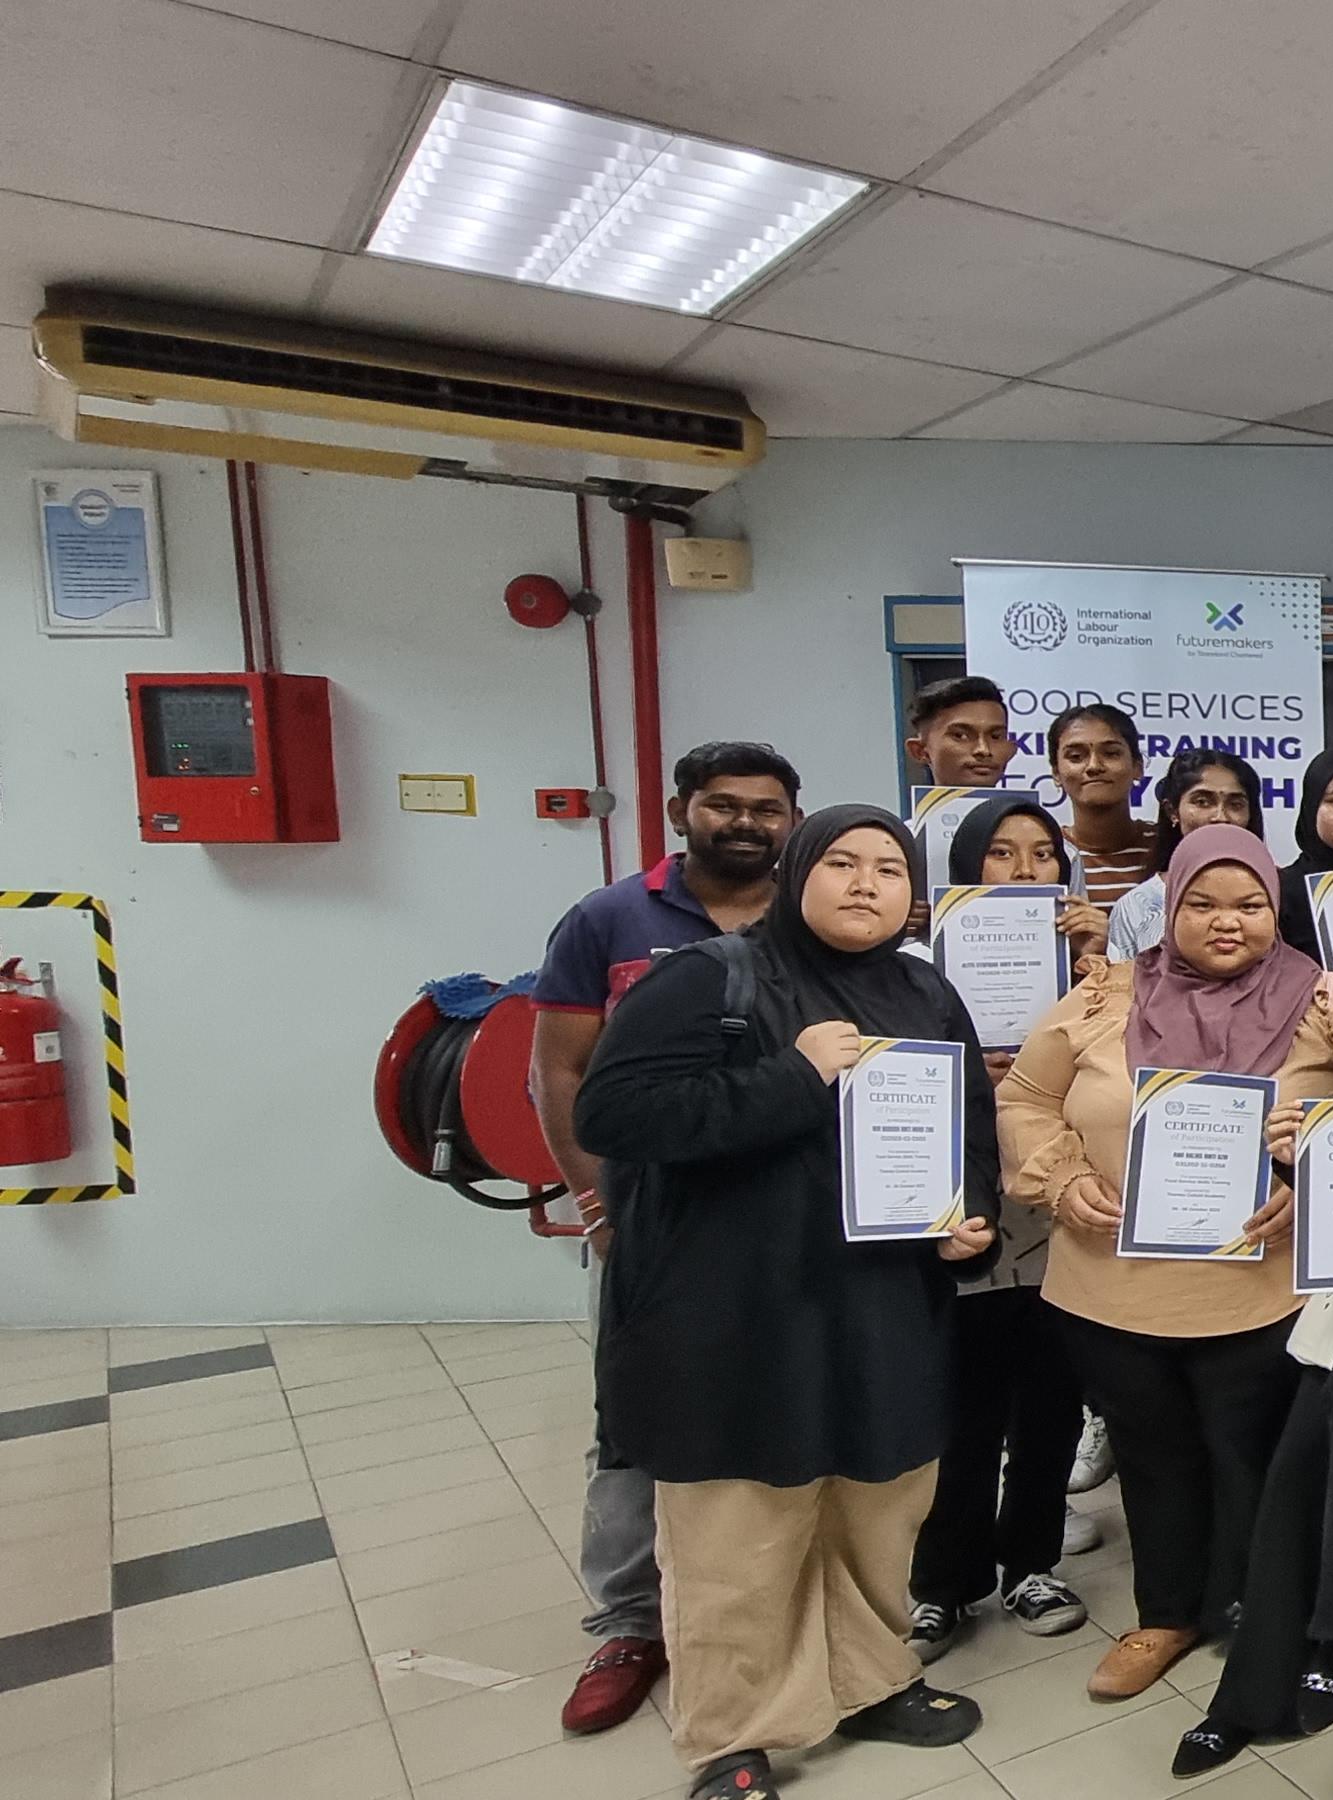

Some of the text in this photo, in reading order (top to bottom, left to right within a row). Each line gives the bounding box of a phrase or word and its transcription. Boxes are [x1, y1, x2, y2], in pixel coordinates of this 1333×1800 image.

[1077, 608, 1152, 620] International
[1077, 621, 1119, 632] Labour
[1077, 634, 1153, 647] Organization
[1176, 634, 1275, 650] futuremakers
[1000, 688, 1304, 722] OOD SERVICES
[961, 932, 1039, 943] CERTIFICATE
[869, 1092, 937, 1105] CERTIFICATE
[1164, 1120, 1245, 1135] CERTIFICATE
